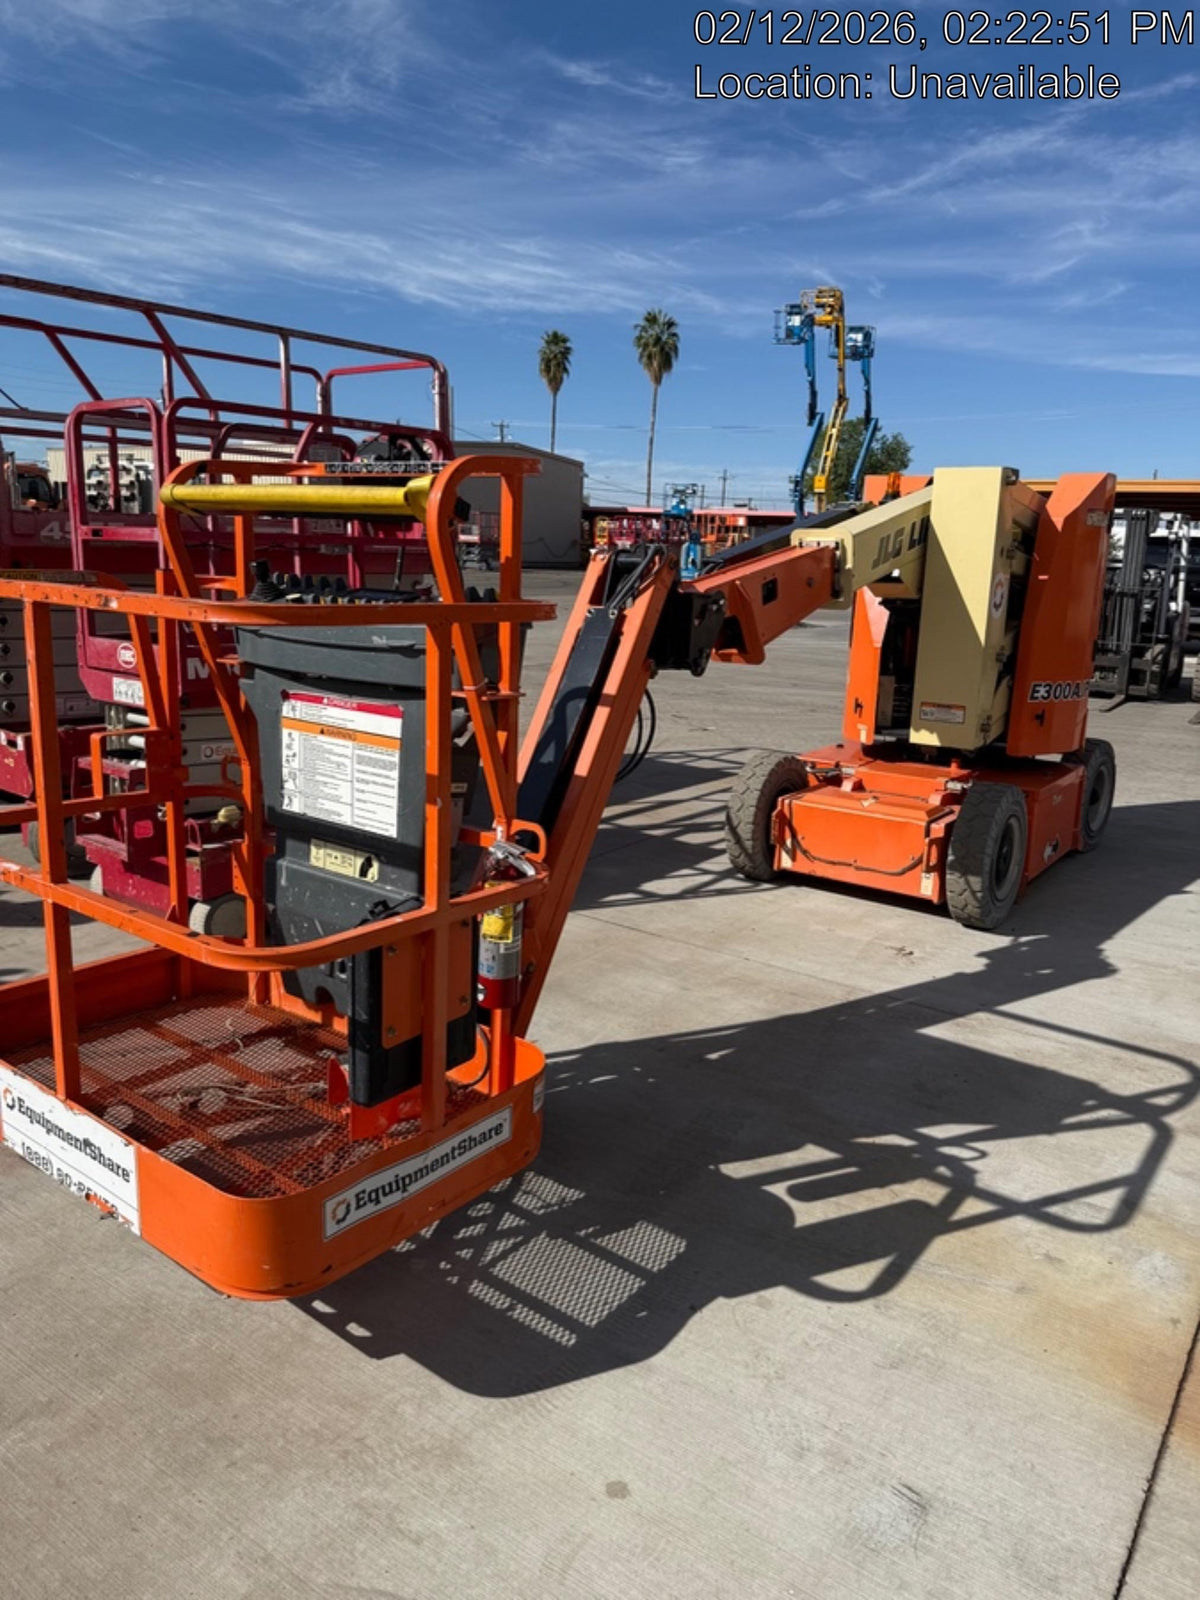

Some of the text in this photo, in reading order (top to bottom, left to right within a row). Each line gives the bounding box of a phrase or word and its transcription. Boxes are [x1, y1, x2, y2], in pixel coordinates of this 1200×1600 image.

[871, 513, 931, 571] JLG LI
[1028, 681, 1088, 703] E300A
[17, 1096, 131, 1183] EquipmentShare
[354, 1121, 504, 1211] EquipmentShare
